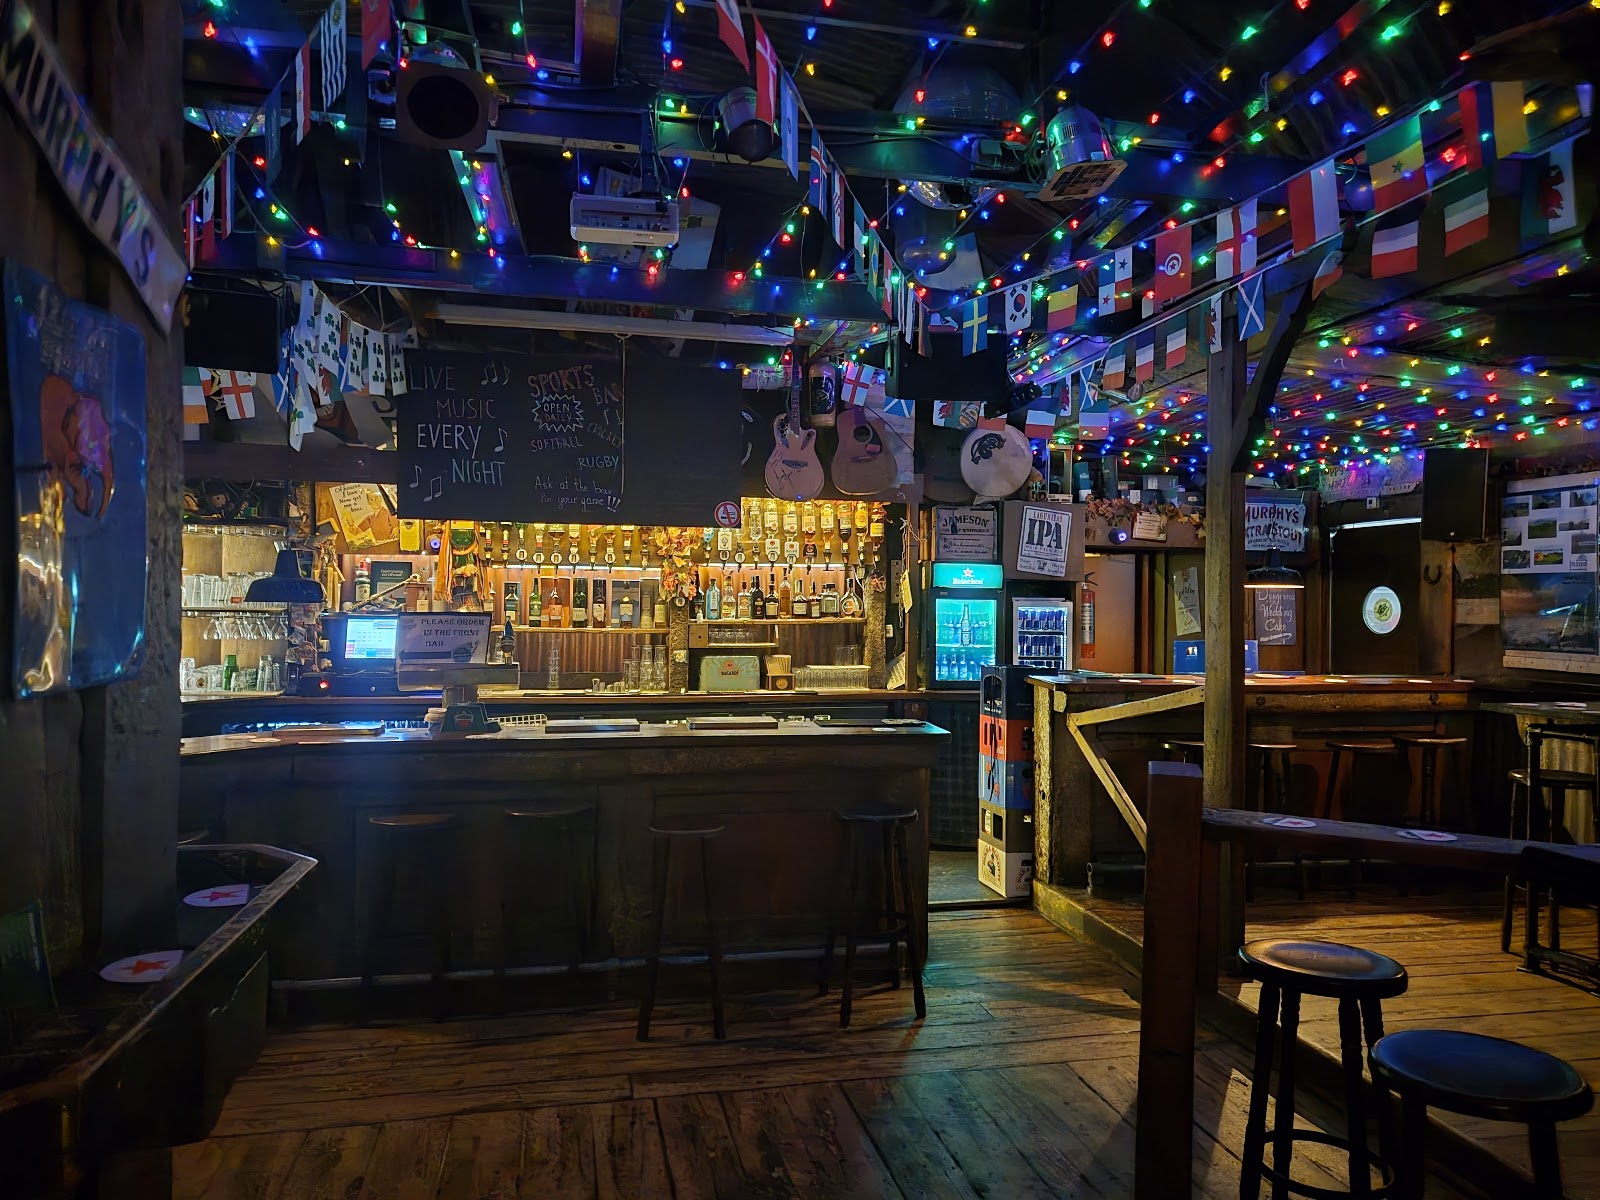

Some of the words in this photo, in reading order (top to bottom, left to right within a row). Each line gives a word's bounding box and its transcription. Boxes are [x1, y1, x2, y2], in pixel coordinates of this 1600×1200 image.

[409, 364, 456, 391] LIVE
[527, 364, 595, 398] SPORTS
[436, 398, 497, 420] MUSIC
[543, 402, 571, 413] OPEN
[544, 413, 573, 423] DAILY
[417, 423, 482, 460] EVERY
[531, 435, 585, 453] SOFTBALL
[452, 458, 506, 487] NIGHT
[577, 455, 620, 473] RUGBY
[534, 475, 554, 491] Ask
[559, 478, 570, 491] at
[573, 477, 589, 493] the
[593, 481, 614, 495] bar
[557, 496, 578, 509] your
[580, 497, 605, 513] game
[1025, 517, 1063, 550] IPA
[952, 577, 984, 585] Heineken
[456, 618, 485, 626] ORDER
[1260, 604, 1293, 623] Wedding
[1264, 618, 1287, 631] Cake
